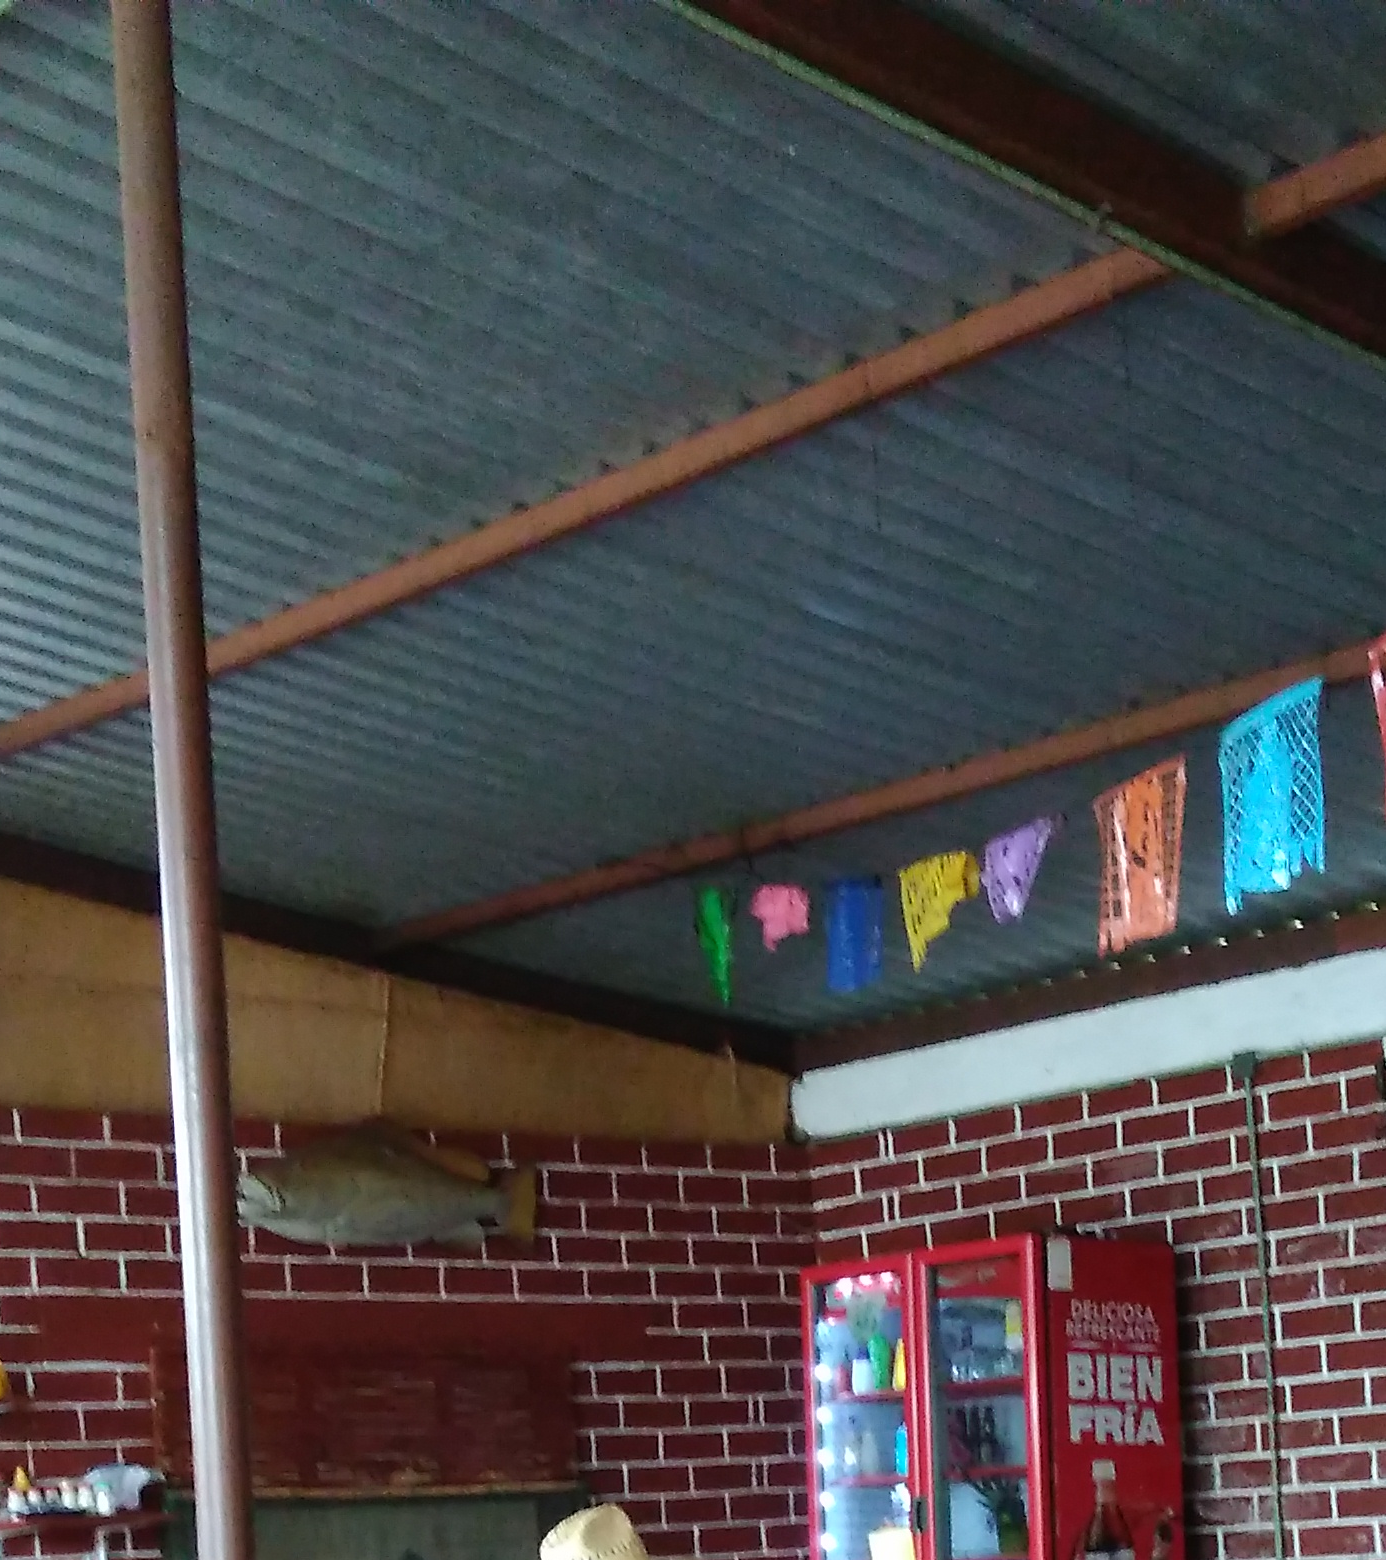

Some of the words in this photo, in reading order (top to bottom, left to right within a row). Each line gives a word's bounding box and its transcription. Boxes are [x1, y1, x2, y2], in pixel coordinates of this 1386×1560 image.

[1071, 1299, 1155, 1325] DELICIOSA
[1067, 1353, 1163, 1402] BIEN
[1068, 1401, 1165, 1446] FRÍA
